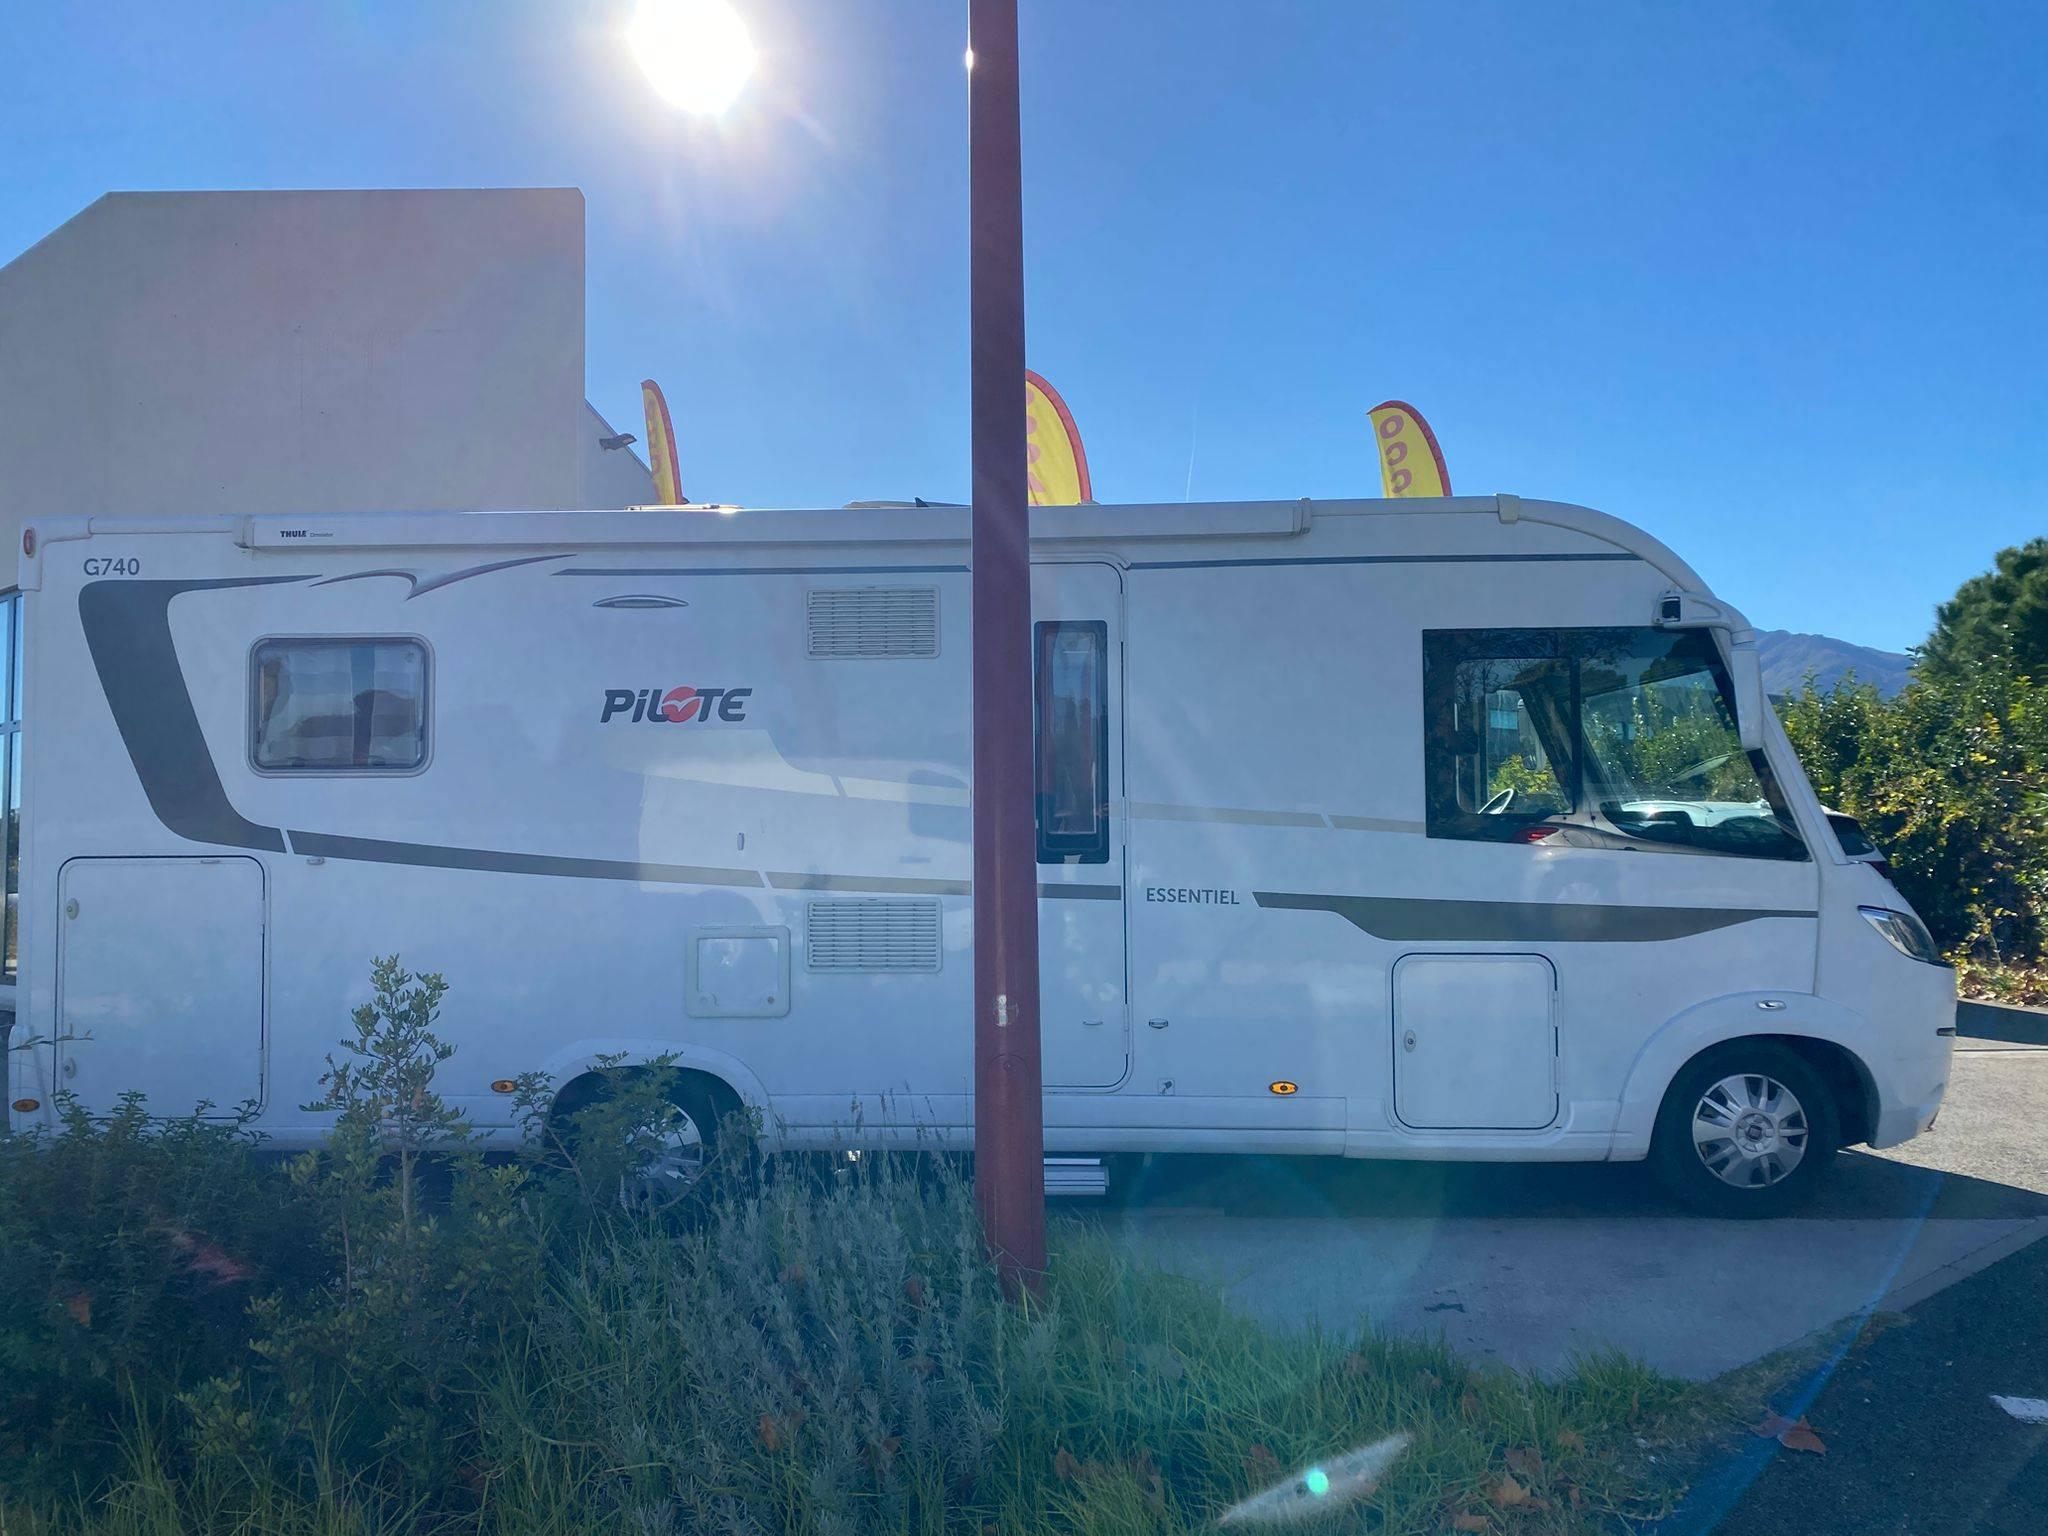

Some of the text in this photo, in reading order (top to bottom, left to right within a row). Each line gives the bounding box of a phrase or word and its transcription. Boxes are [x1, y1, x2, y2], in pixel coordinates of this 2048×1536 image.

[280, 530, 307, 538] THULE
[83, 558, 140, 576] G740
[1146, 887, 1240, 905] ESSENTIEL
